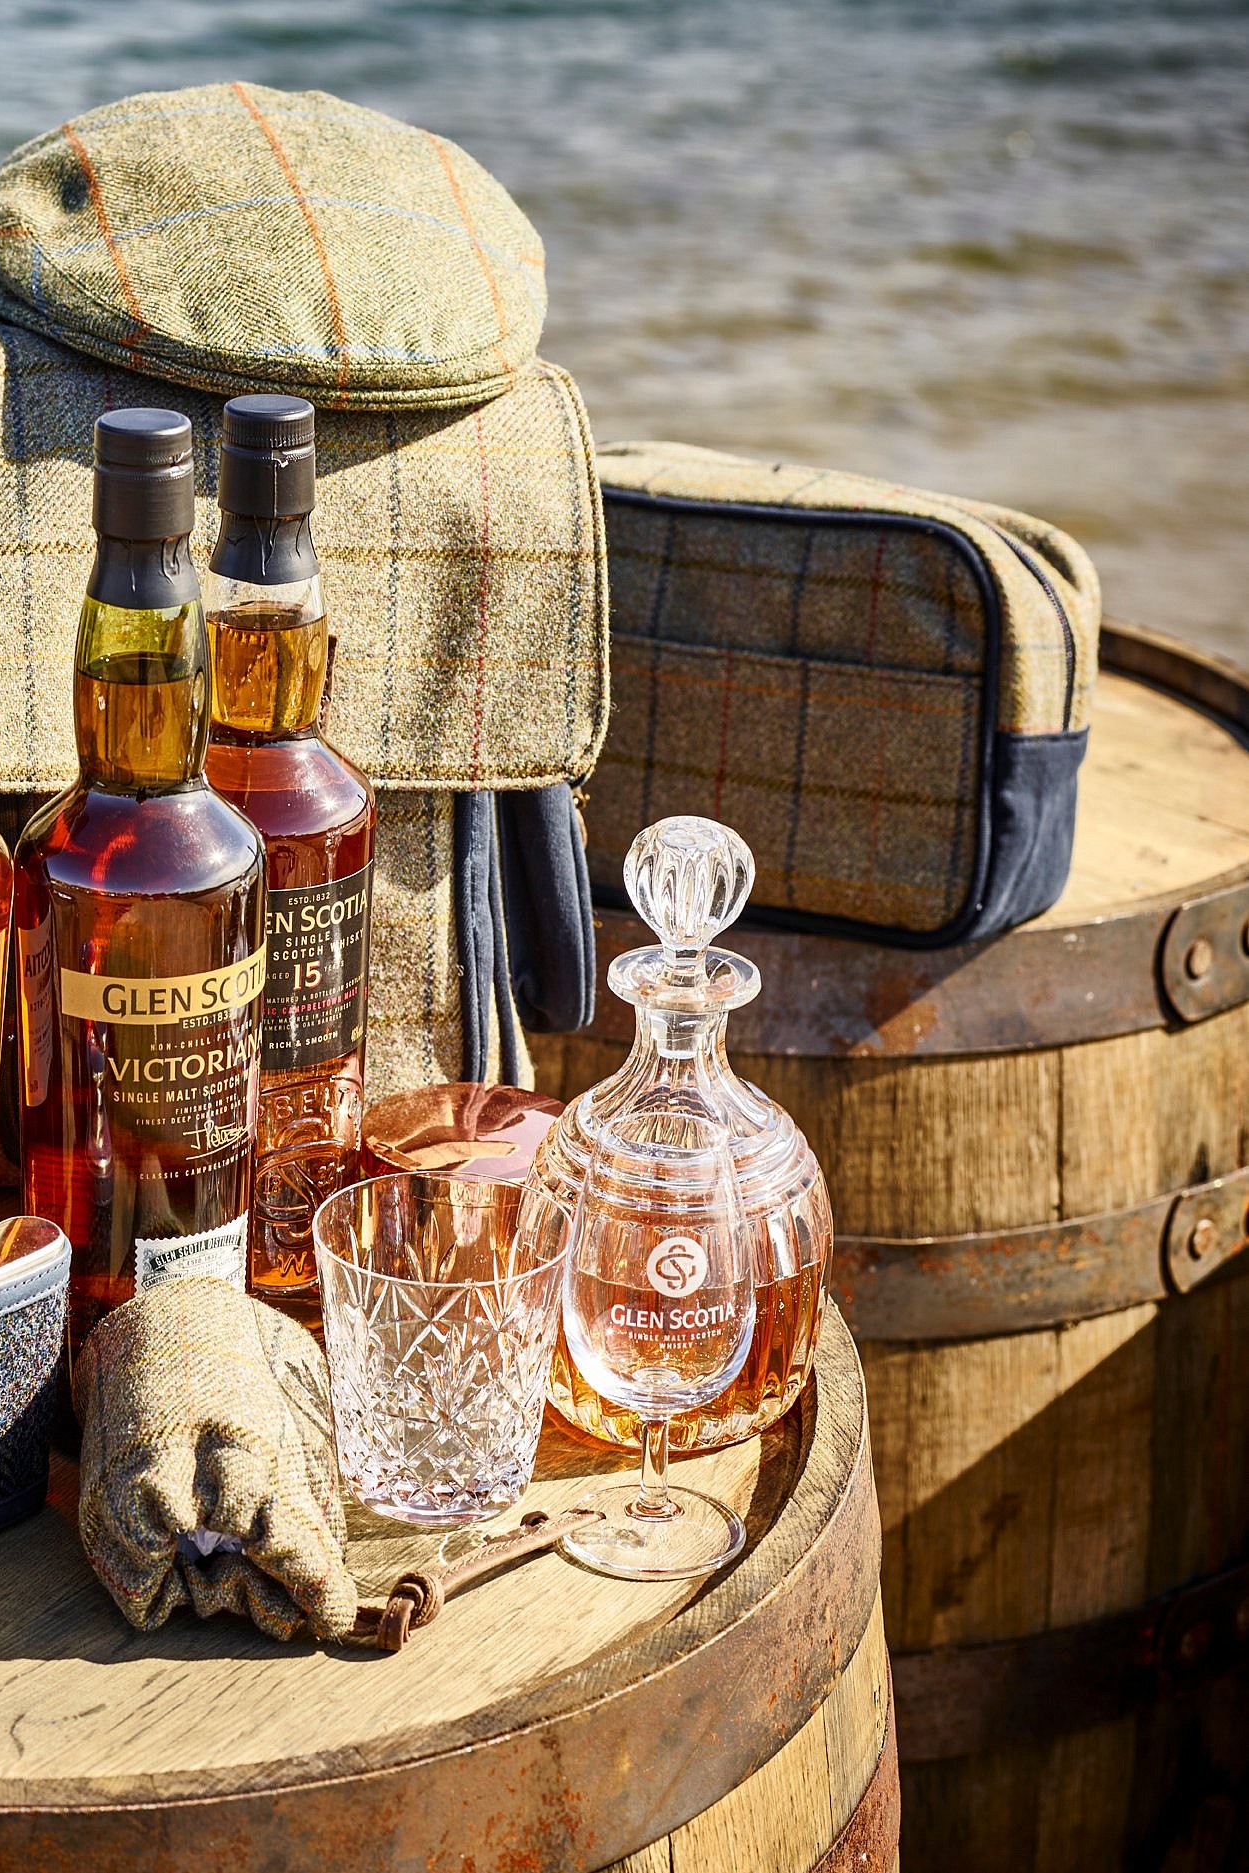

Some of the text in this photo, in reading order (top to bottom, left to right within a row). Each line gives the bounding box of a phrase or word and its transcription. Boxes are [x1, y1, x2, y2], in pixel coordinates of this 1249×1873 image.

[300, 889, 368, 932] SCOTIA
[273, 928, 364, 961] SCOTCH WHISKY
[286, 931, 331, 948] SINGLE
[293, 960, 323, 991] 15
[102, 983, 191, 1018] GLEN
[107, 1022, 263, 1083] VICTORIANA
[150, 1036, 211, 1051] NON-CHILL
[269, 1031, 338, 1050] RICH & SMOOTH
[113, 1077, 240, 1103] SINGLE MALT SCOTCH
[175, 1103, 212, 1115] FINISHED
[215, 1099, 223, 1107] IN
[136, 1118, 166, 1126] FINEST
[171, 1115, 192, 1124] DEEP
[140, 1171, 179, 1180] CLASSIC
[155, 1251, 176, 1266] GLEN
[178, 1241, 206, 1258] SCOTIA
[611, 1303, 736, 1330] GLEN SCOTIA
[628, 1332, 659, 1342] SINGLE
[690, 1329, 722, 1339] SCOTCH
